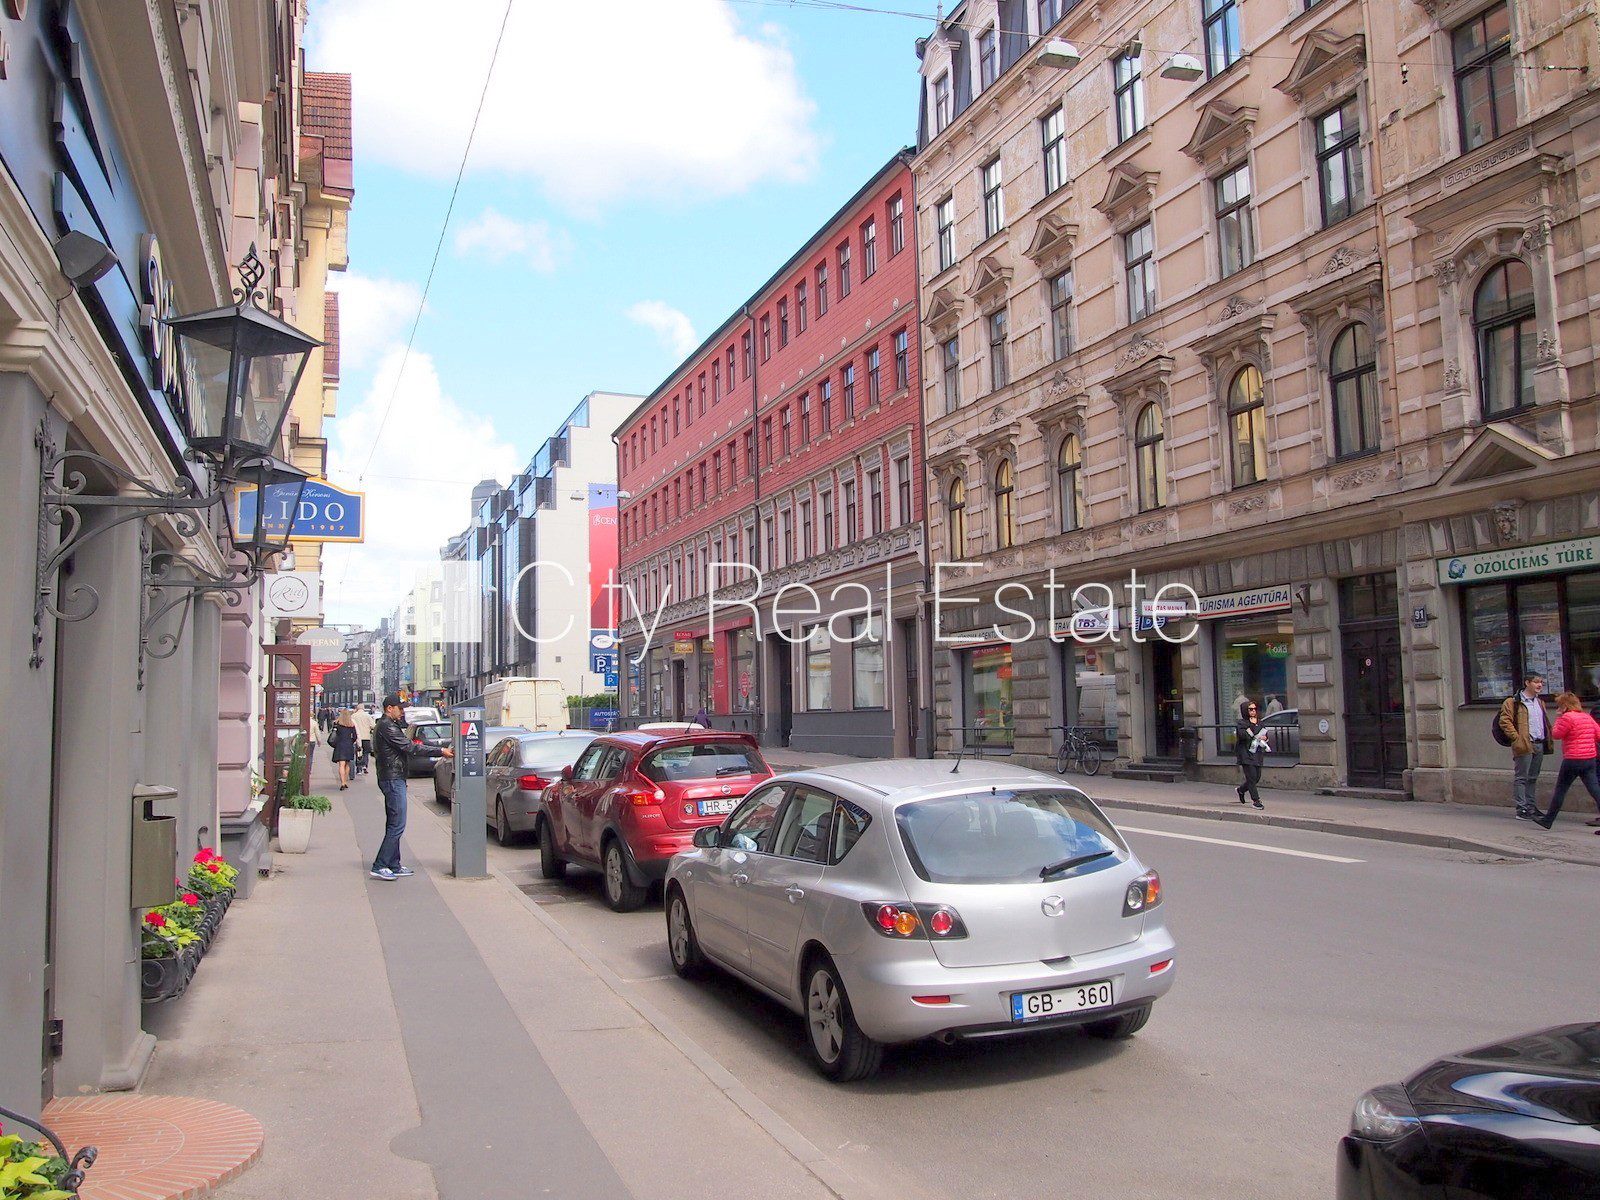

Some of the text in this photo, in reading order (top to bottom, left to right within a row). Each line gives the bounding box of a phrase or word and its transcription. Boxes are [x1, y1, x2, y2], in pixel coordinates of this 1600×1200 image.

[1474, 547, 1594, 575] OZOLCIEMS TŪRE
[1237, 589, 1289, 607] AGENTŪRA
[1414, 610, 1425, 620] 91
[466, 722, 479, 736] A
[1077, 985, 1108, 1007] 360
